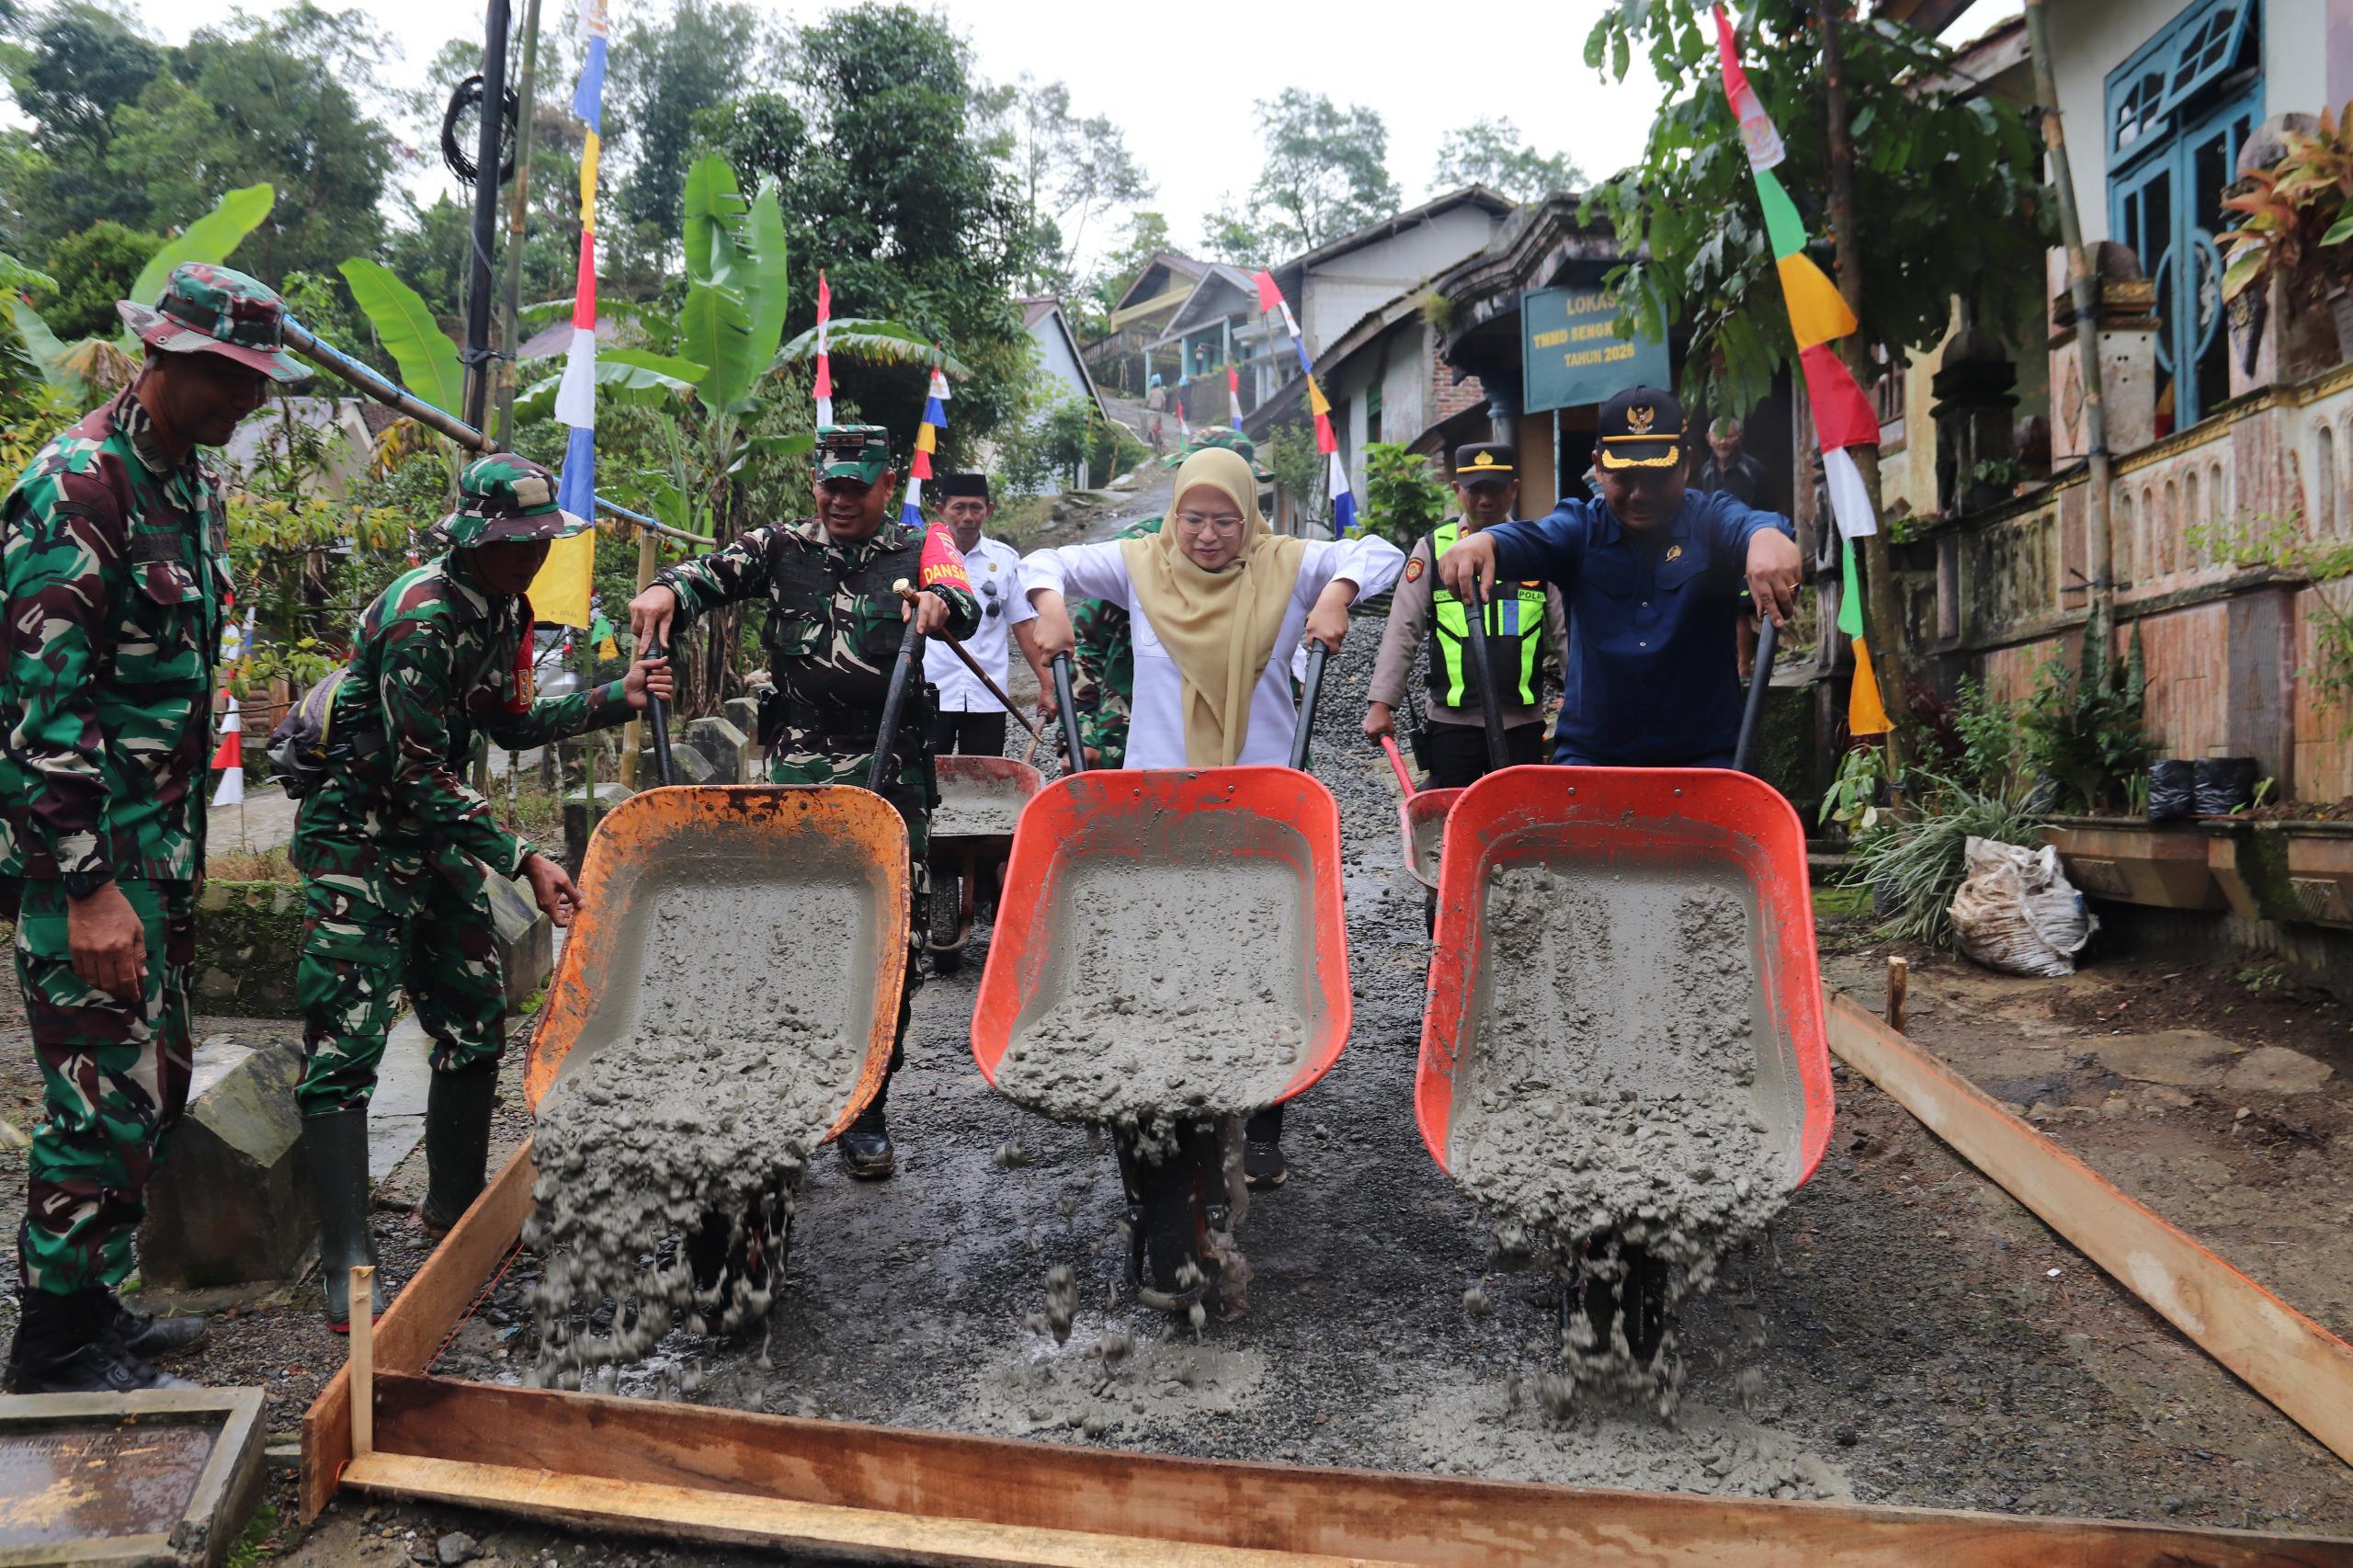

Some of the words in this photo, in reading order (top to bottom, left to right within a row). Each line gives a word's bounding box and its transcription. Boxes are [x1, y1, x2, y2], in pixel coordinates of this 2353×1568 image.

[1566, 290, 1620, 315] LOKAS
[1533, 329, 1568, 348] TMMD
[1564, 350, 1602, 367] TAHUN
[1518, 590, 1544, 600] POLRI
